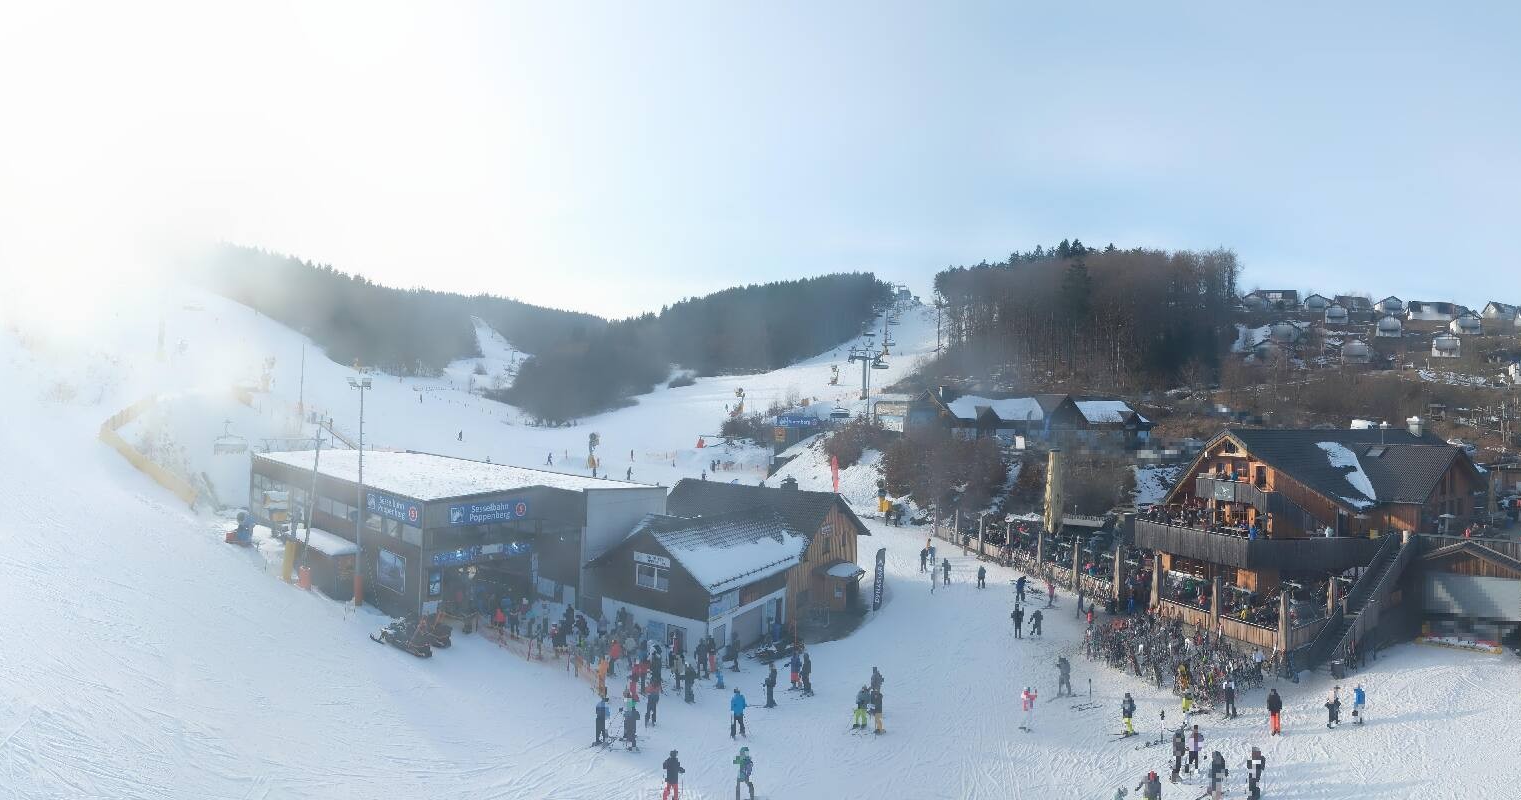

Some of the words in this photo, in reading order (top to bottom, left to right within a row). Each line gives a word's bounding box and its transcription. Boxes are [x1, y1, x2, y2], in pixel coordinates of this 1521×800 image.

[471, 503, 509, 513] Sesselbahn
[469, 511, 511, 523] Poppenberg
[874, 566, 884, 604] DYNASTAR
